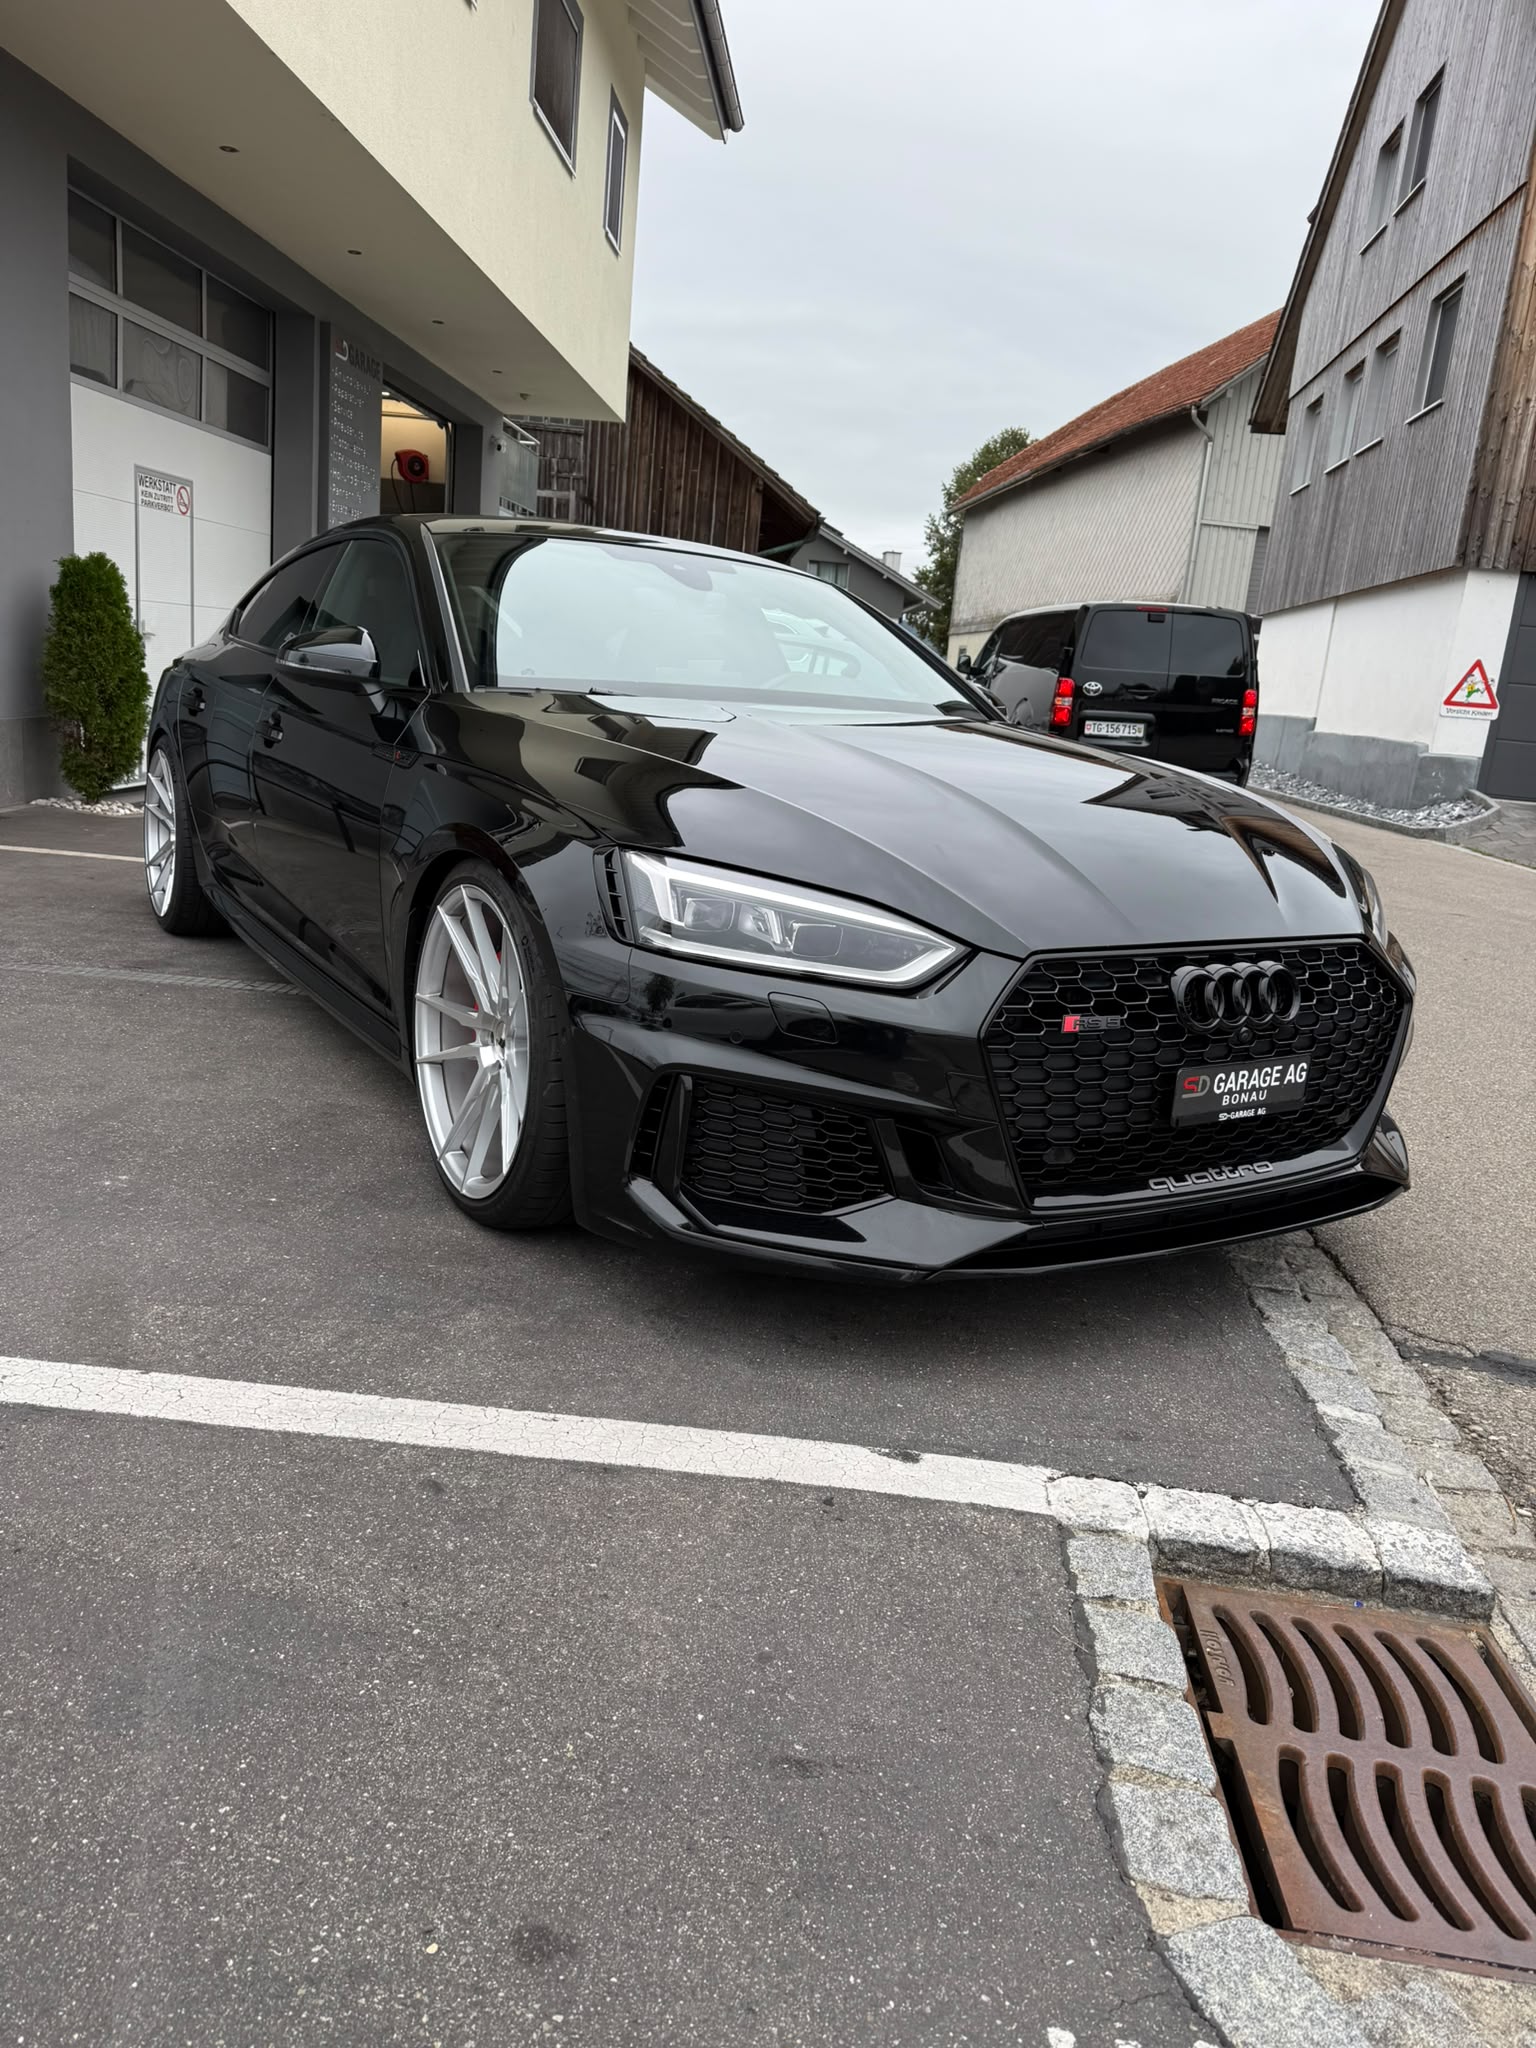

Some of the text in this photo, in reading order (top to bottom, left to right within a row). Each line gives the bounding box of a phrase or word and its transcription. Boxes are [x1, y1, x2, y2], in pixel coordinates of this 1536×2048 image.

[349, 343, 381, 382] GARAGE
[138, 473, 176, 495] WERKSTATT
[141, 490, 174, 504] KEIN ZUTRITT
[141, 498, 174, 513] PARKVERBOT
[1445, 707, 1470, 715] Vorsicht
[1213, 1065, 1283, 1094] GARAGE
[1283, 1062, 1308, 1085] AG
[1221, 1089, 1268, 1106] BONAU
[1256, 1107, 1267, 1116] AG
[1148, 1160, 1274, 1192] quattro
